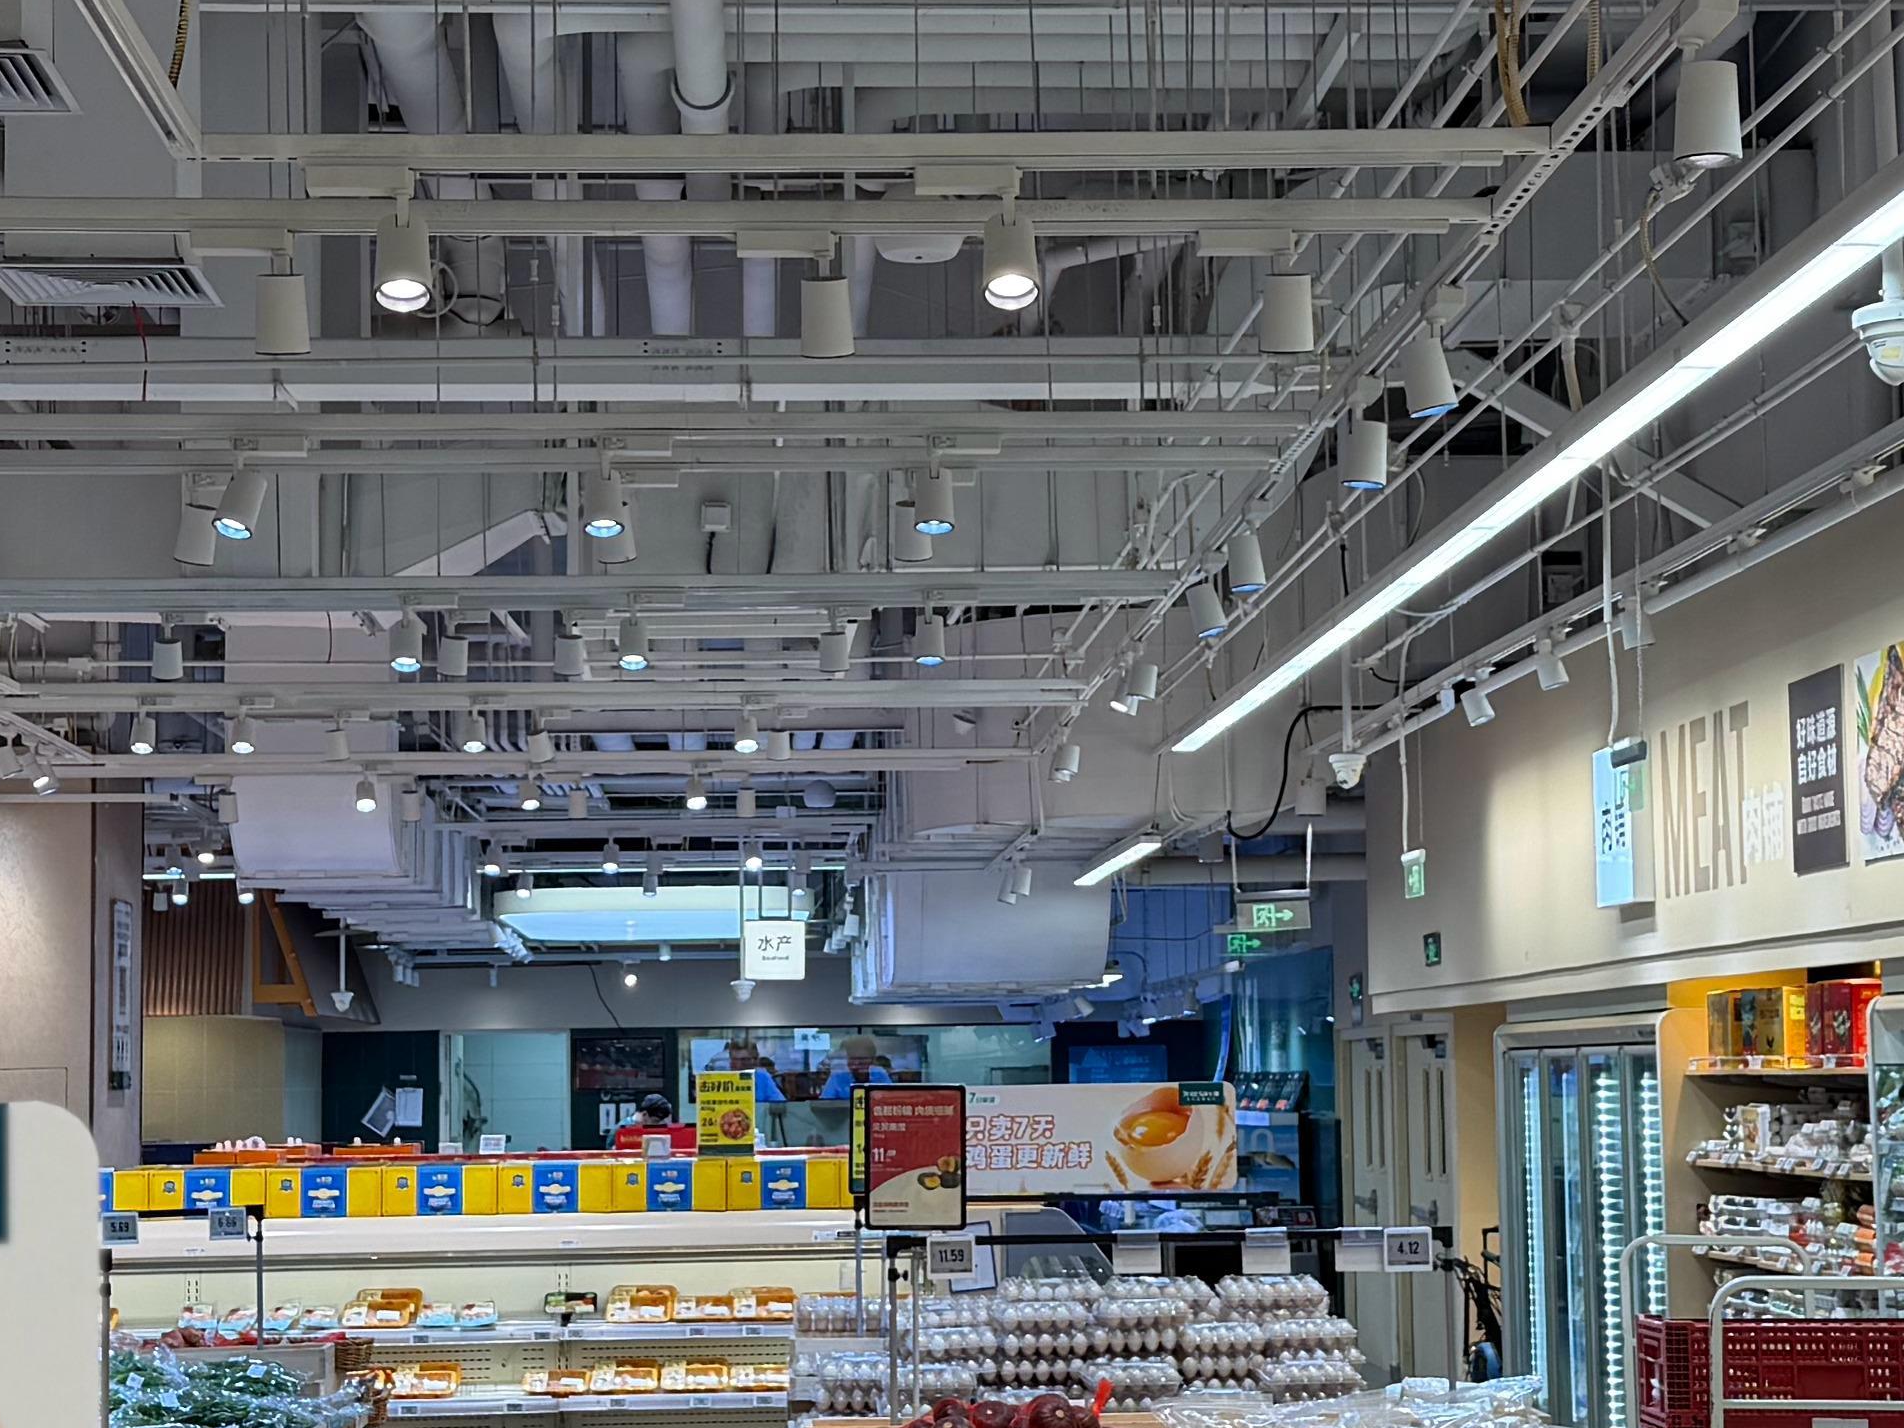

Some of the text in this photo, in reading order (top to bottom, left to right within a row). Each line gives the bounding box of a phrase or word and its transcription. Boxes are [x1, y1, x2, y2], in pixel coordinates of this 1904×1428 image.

[1660, 700, 1749, 899] MEAT
[758, 935, 792, 952] 水产
[965, 1114, 1056, 1141] 只卖7天
[965, 1141, 1093, 1171] 鸡蛋更新鲜
[939, 1249, 965, 1263] 11.59
[1397, 1241, 1420, 1255] 4.12
